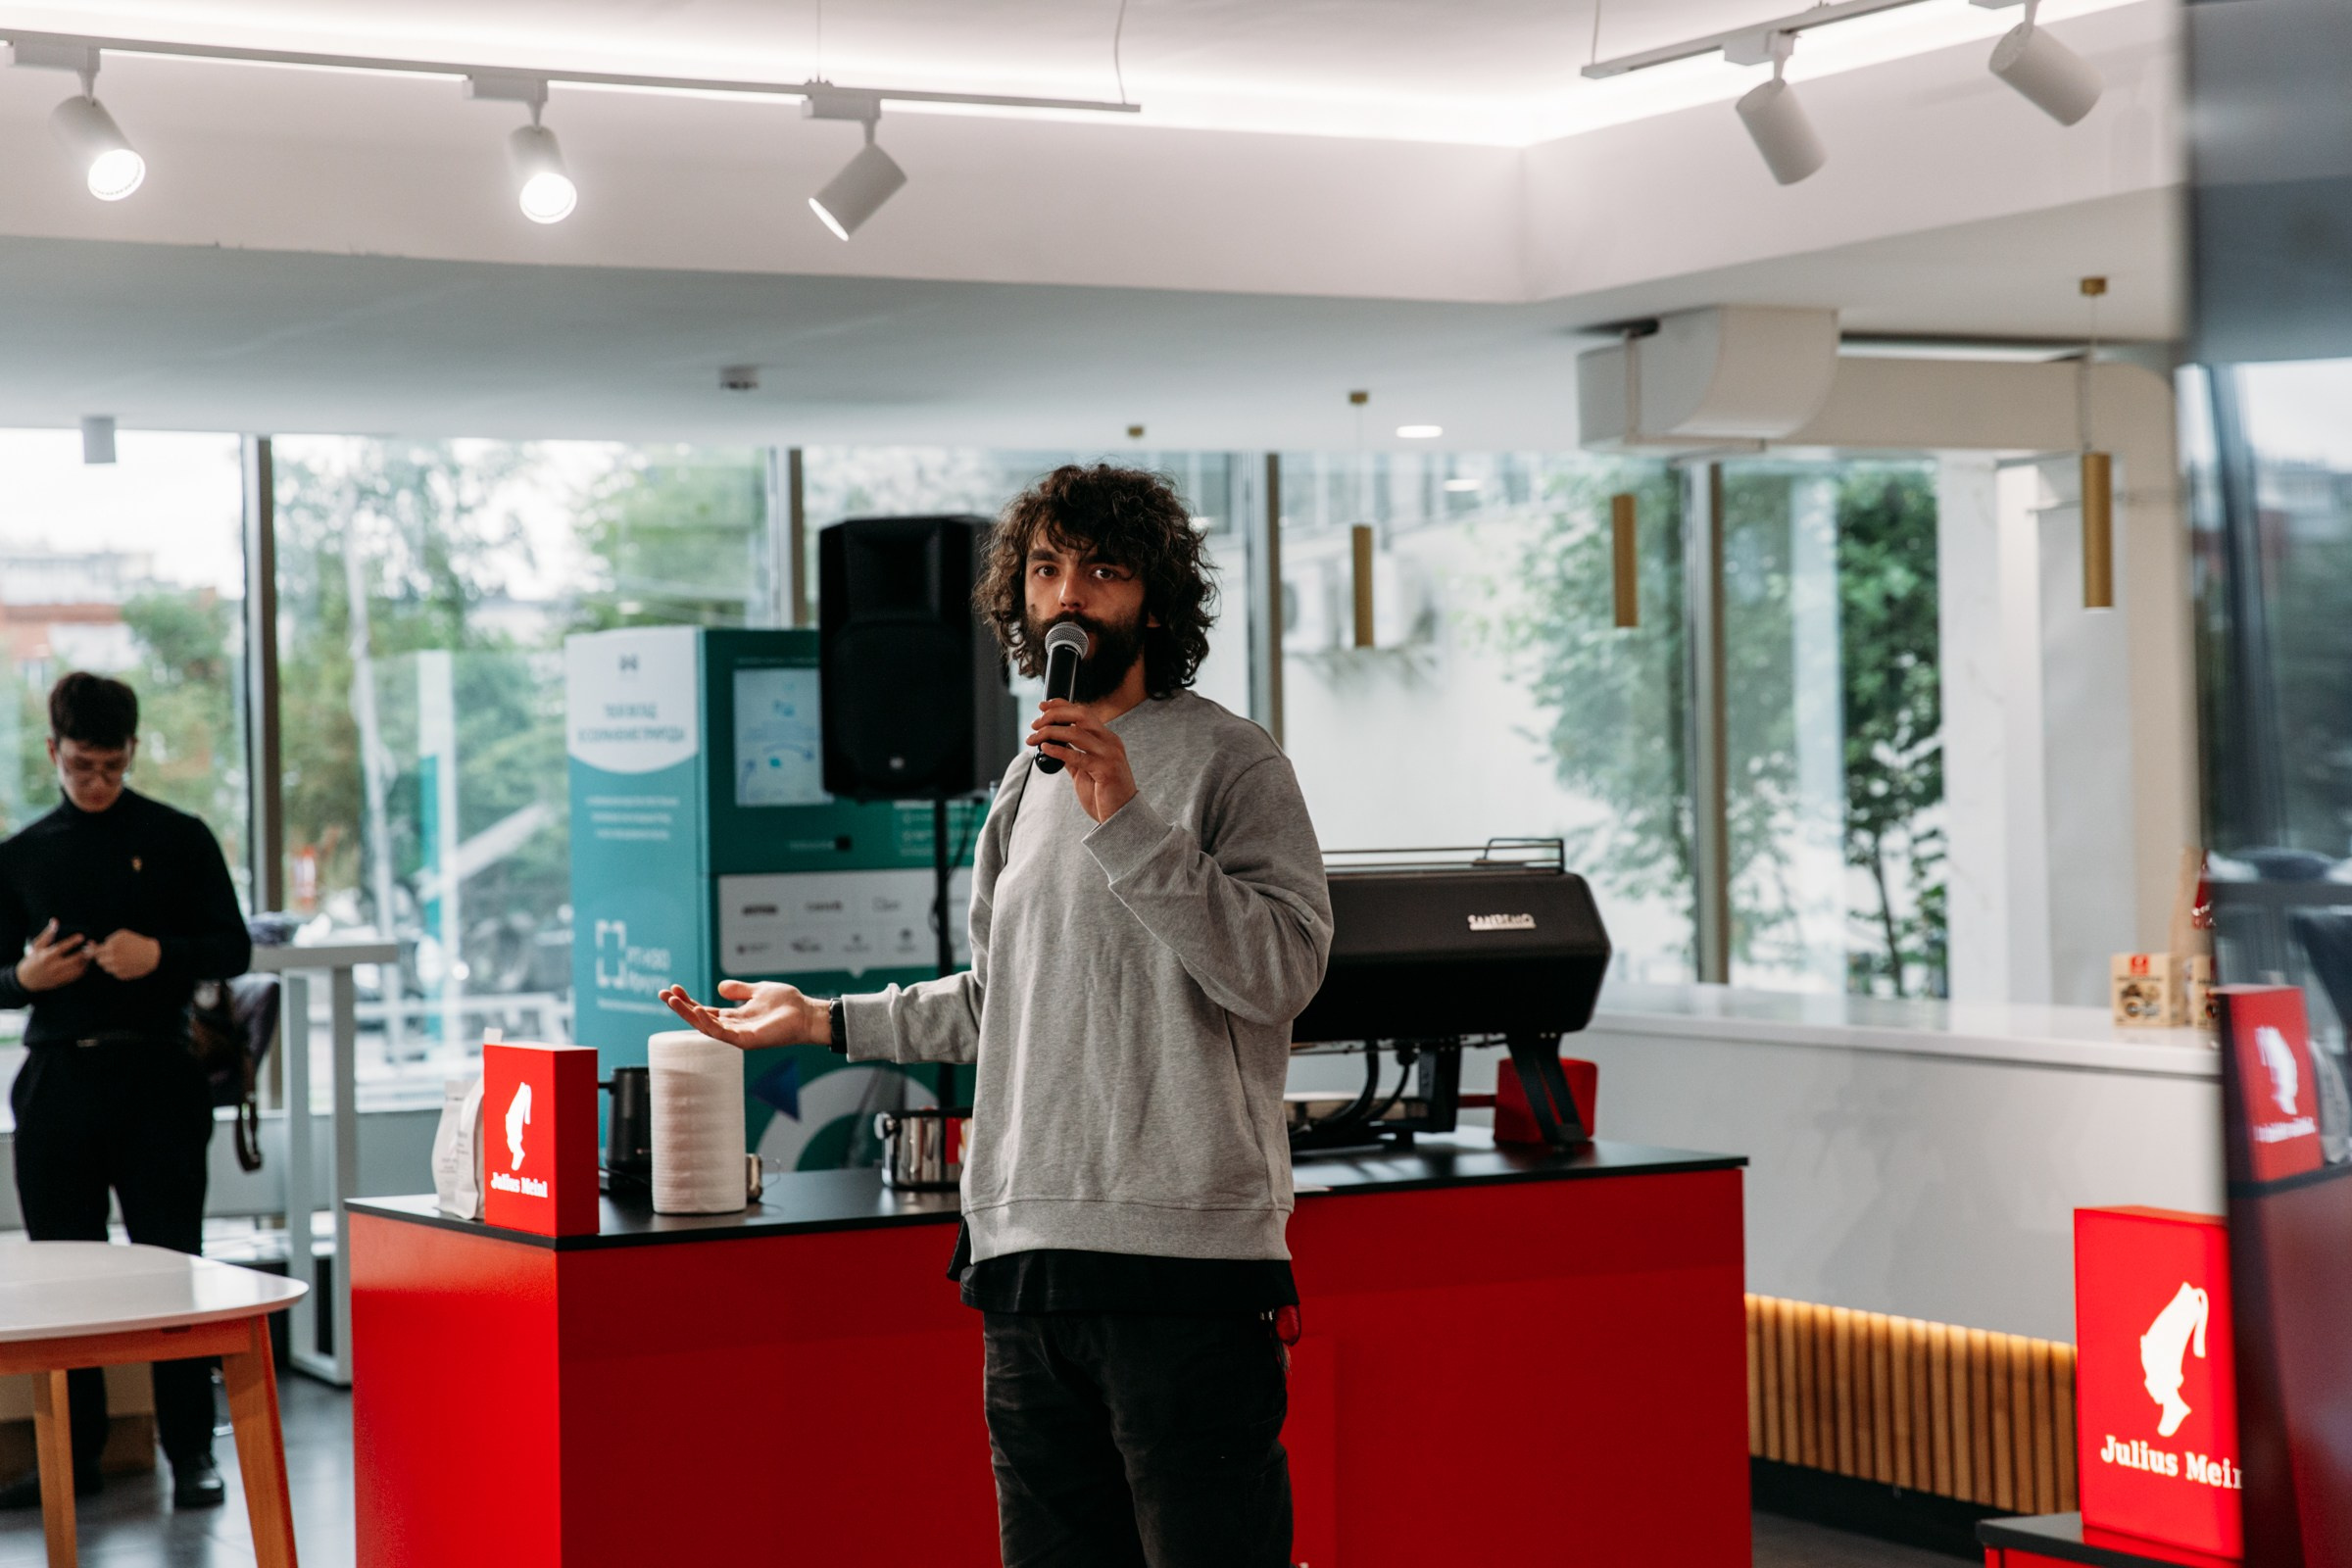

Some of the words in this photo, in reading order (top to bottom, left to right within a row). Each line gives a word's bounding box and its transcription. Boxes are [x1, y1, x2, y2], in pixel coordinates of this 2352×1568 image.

[490, 1171, 520, 1193] Julius
[520, 1177, 548, 1198] Meinl
[2100, 1434, 2179, 1477] Julius
